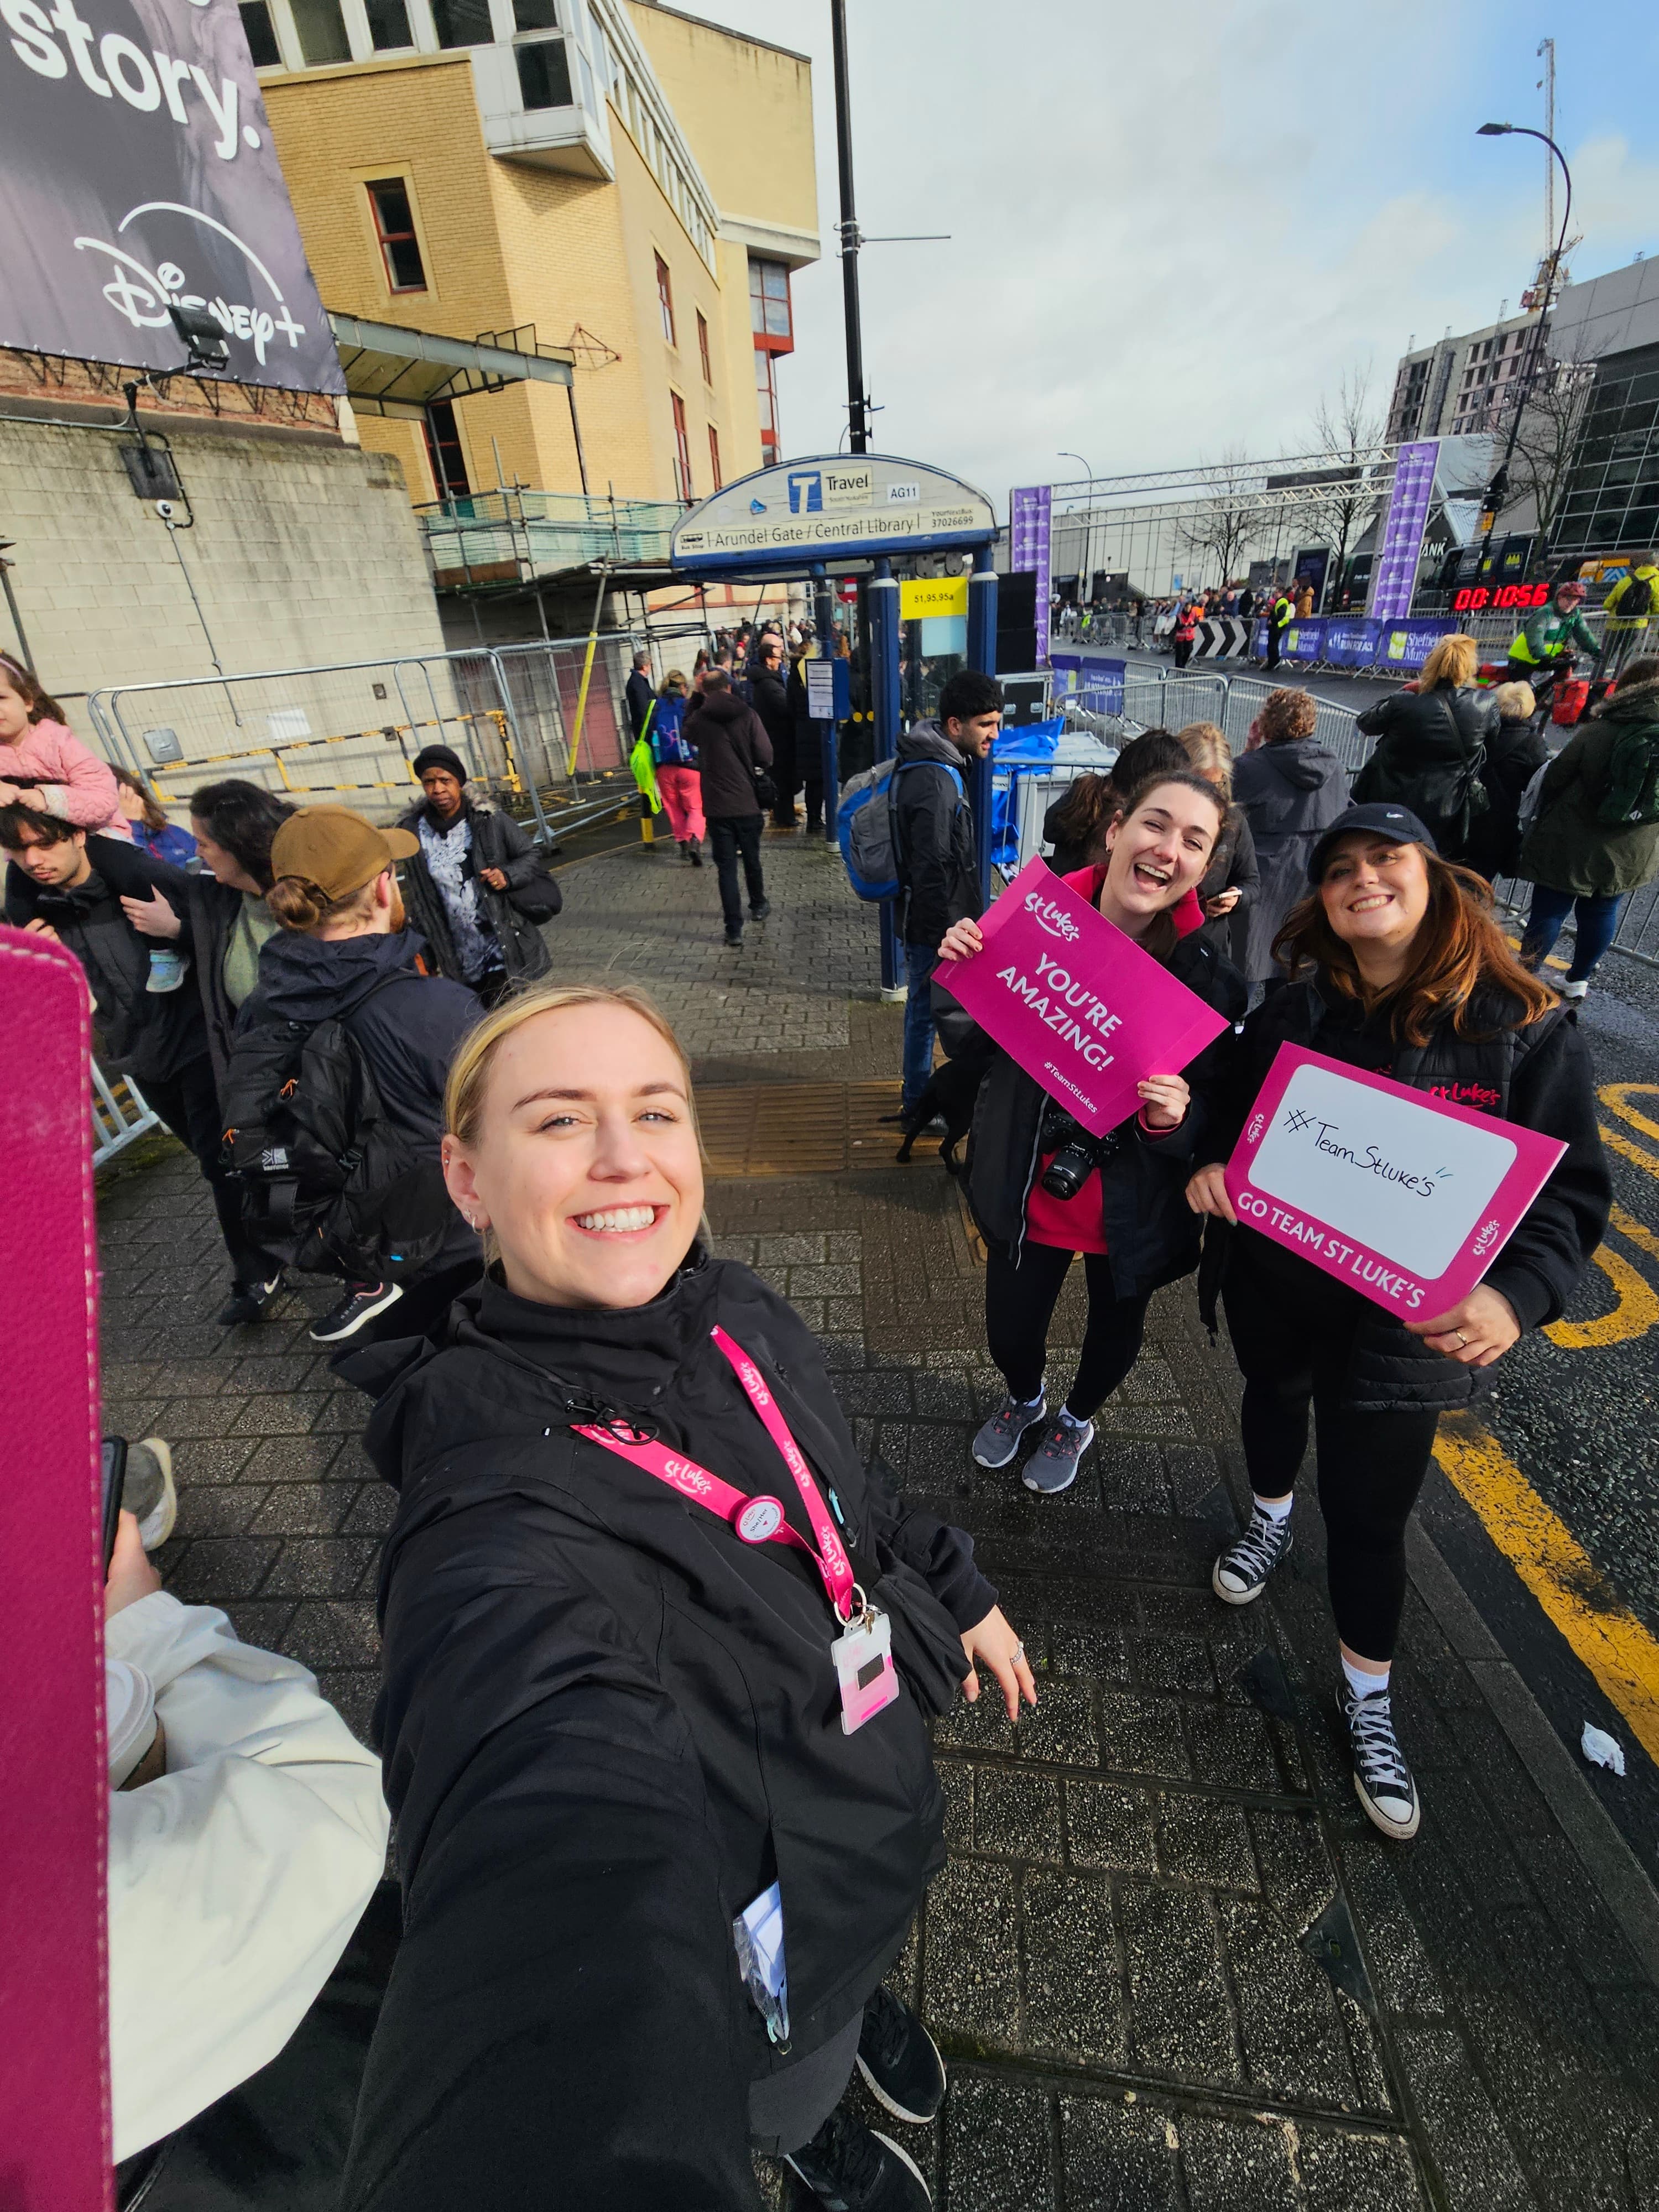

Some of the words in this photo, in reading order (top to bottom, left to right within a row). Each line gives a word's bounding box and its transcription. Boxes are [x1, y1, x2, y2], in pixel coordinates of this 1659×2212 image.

[0, 0, 260, 160] story.
[826, 473, 868, 491] Travel
[890, 486, 916, 498] AG11
[715, 528, 768, 547] Arundel
[772, 527, 803, 541] Gate
[815, 520, 863, 538] Central
[867, 518, 914, 534] Library
[932, 515, 974, 528] 37026699
[1453, 583, 1550, 611] 00:10:56
[1043, 901, 1079, 942] Luke's
[1035, 952, 1123, 1038] YOU'RE
[996, 966, 1114, 1071] AMAZING!
[1044, 1061, 1098, 1114] #TeamStLukes
[1238, 1192, 1268, 1218] GO
[1270, 1207, 1325, 1250] TEAM
[1323, 1239, 1354, 1264] ST
[1350, 1254, 1426, 1308] LUKE'S
[665, 1460, 682, 1478] St
[680, 1464, 712, 1495] Luke's
[750, 1509, 768, 1532] She/Her
